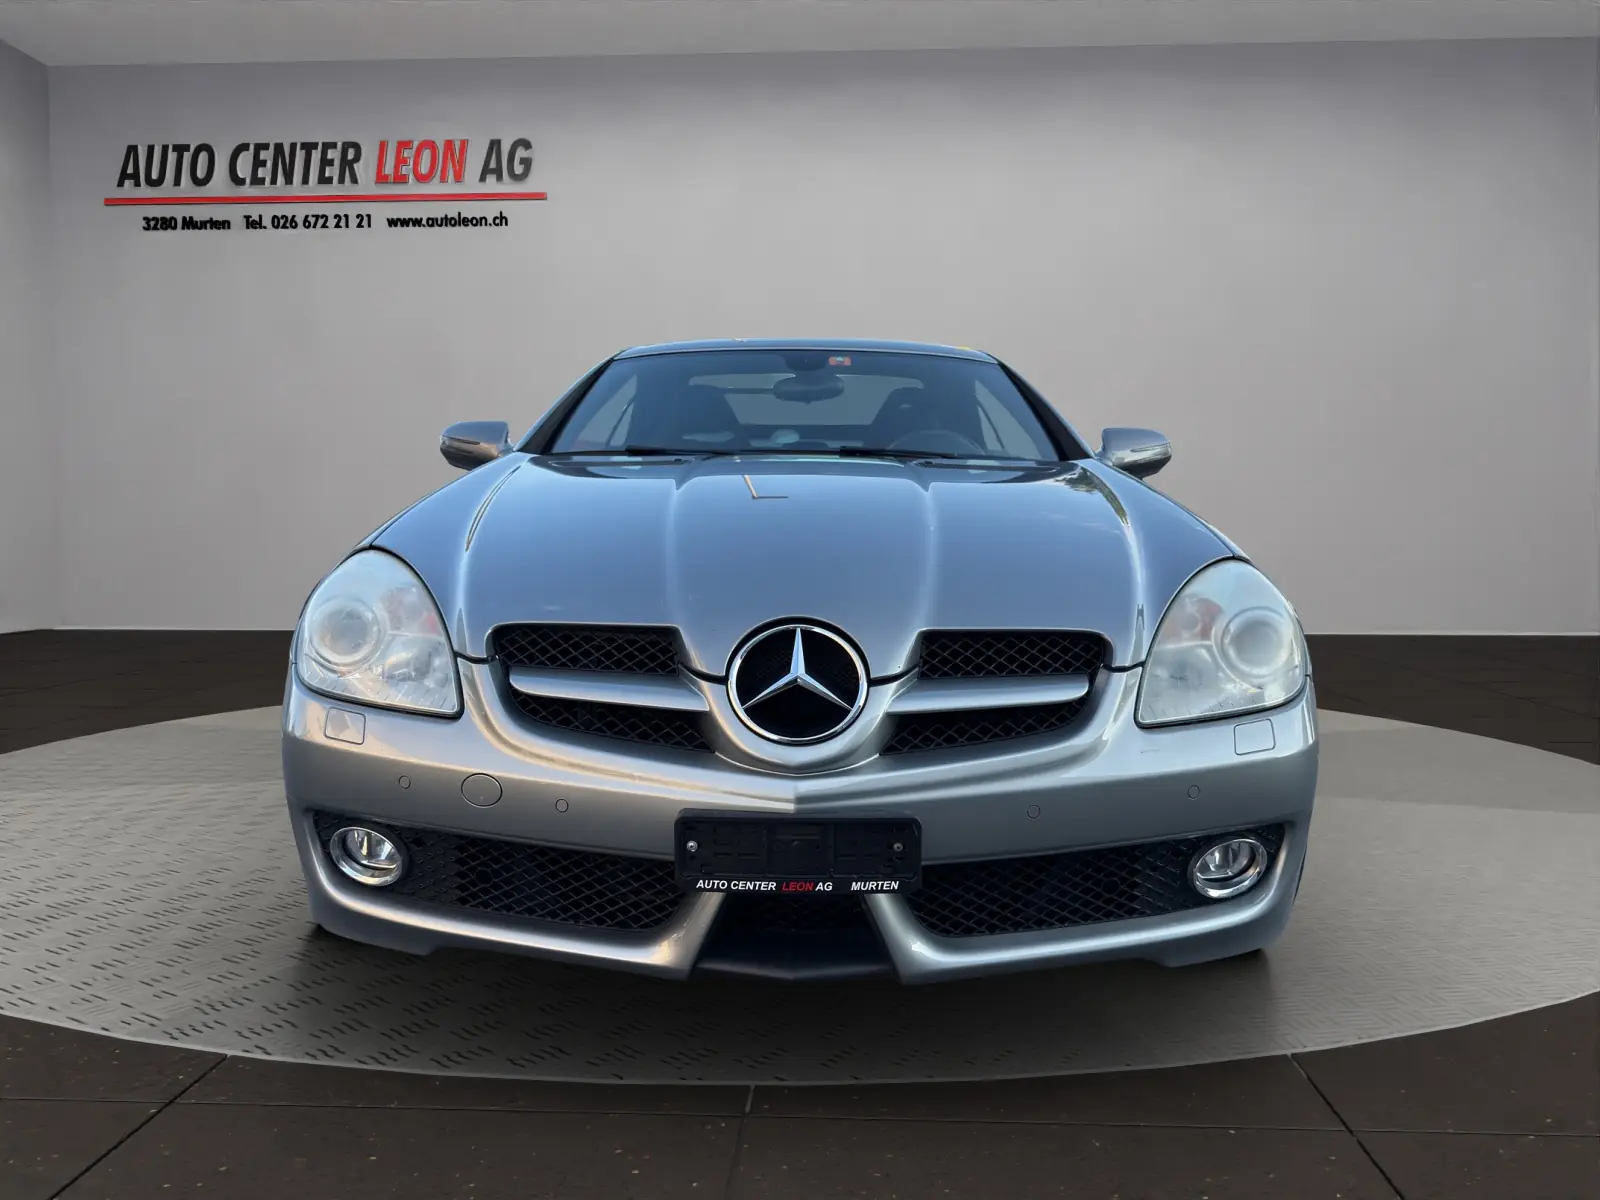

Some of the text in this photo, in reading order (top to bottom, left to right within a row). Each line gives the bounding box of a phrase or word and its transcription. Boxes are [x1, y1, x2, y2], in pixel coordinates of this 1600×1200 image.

[116, 138, 534, 188] AUTO CENTER LEON AG
[141, 212, 509, 231] 3280 Murten Tel. 026 672 21 21 www.autoleon.ch
[696, 879, 899, 892] AUTO CENTER LEON AG MURTEN
